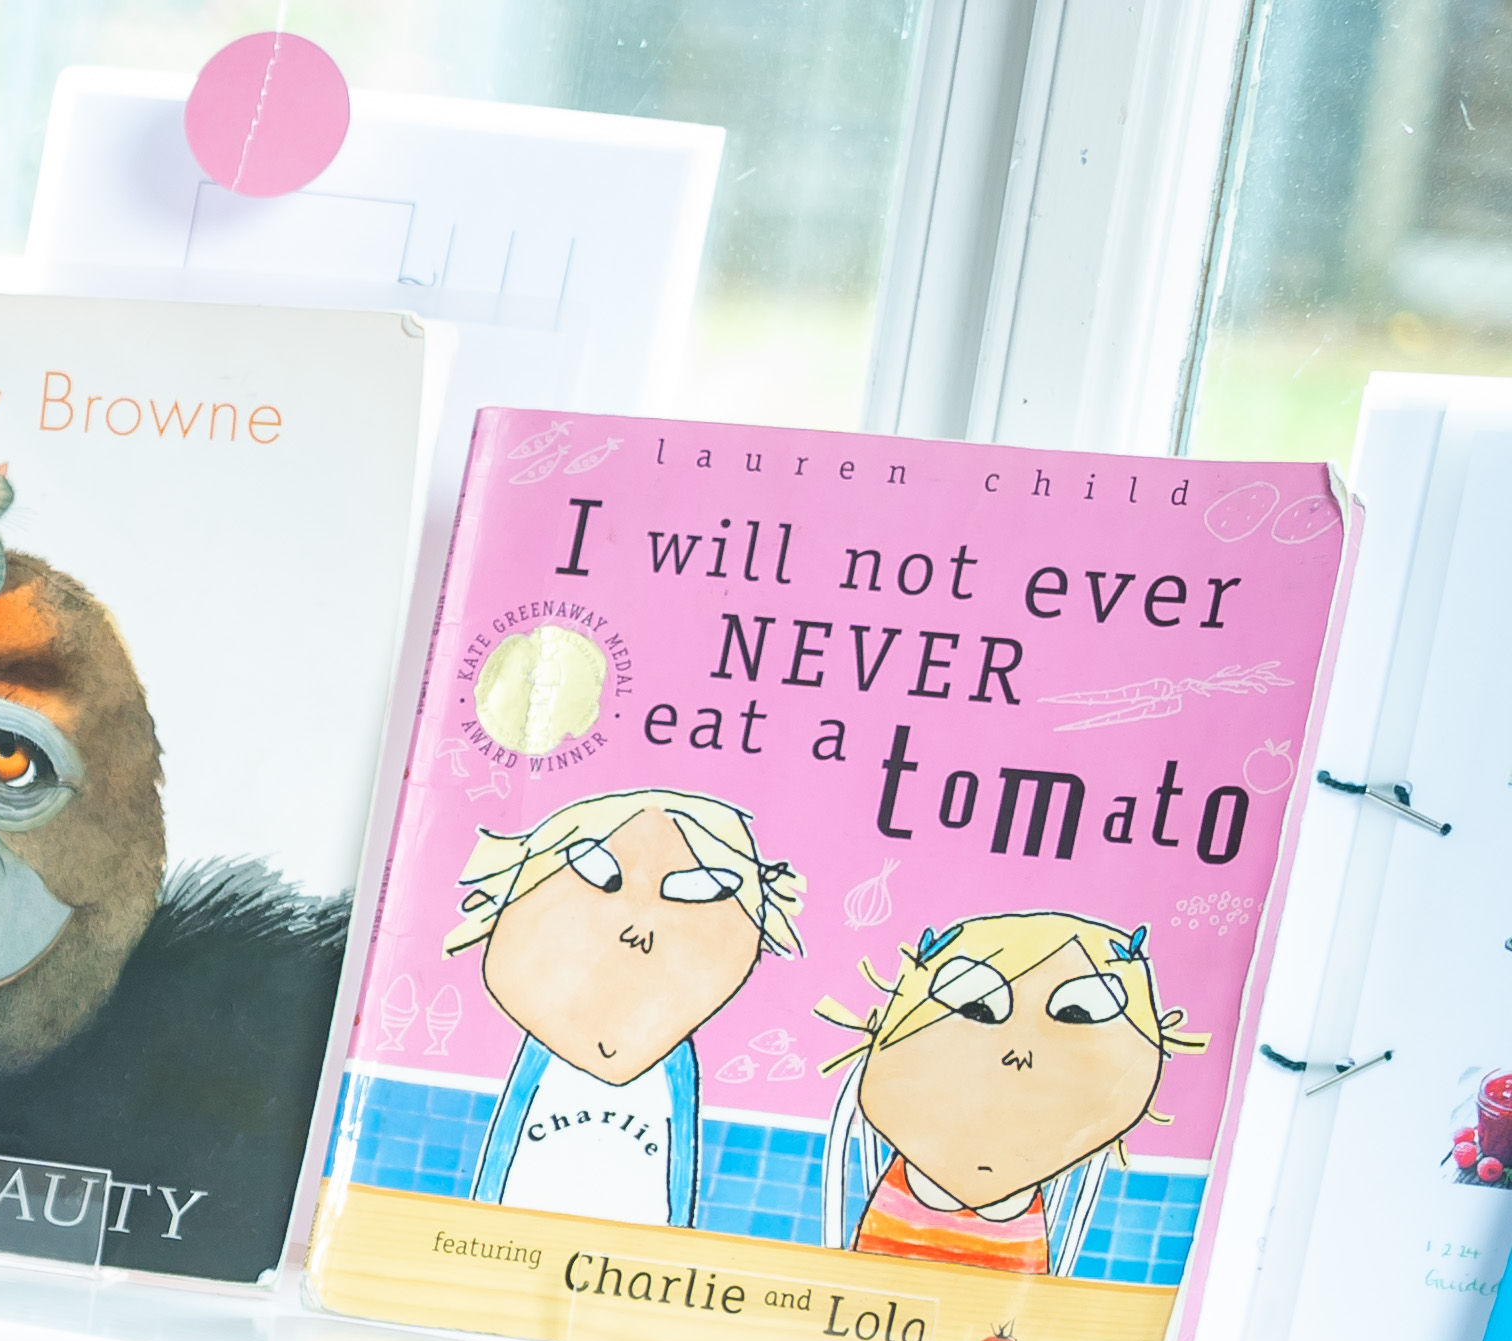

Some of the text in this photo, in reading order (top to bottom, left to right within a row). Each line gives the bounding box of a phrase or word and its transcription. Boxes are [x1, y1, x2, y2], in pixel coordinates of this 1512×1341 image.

[39, 371, 284, 445] Browne
[655, 438, 1193, 508] lauren child
[553, 497, 1242, 630] I will not ever
[457, 634, 491, 681] KATE
[492, 601, 608, 633] GREENAWAY
[604, 633, 632, 697] MEDAL
[710, 613, 1026, 705] NEVER
[461, 720, 608, 772] AWARD WINNER
[642, 697, 848, 763] eat a
[873, 724, 1252, 866] tomato
[525, 1105, 662, 1159] Charlie
[431, 1230, 543, 1271] featuring
[562, 1250, 748, 1317] Charlie
[763, 1288, 814, 1314] and
